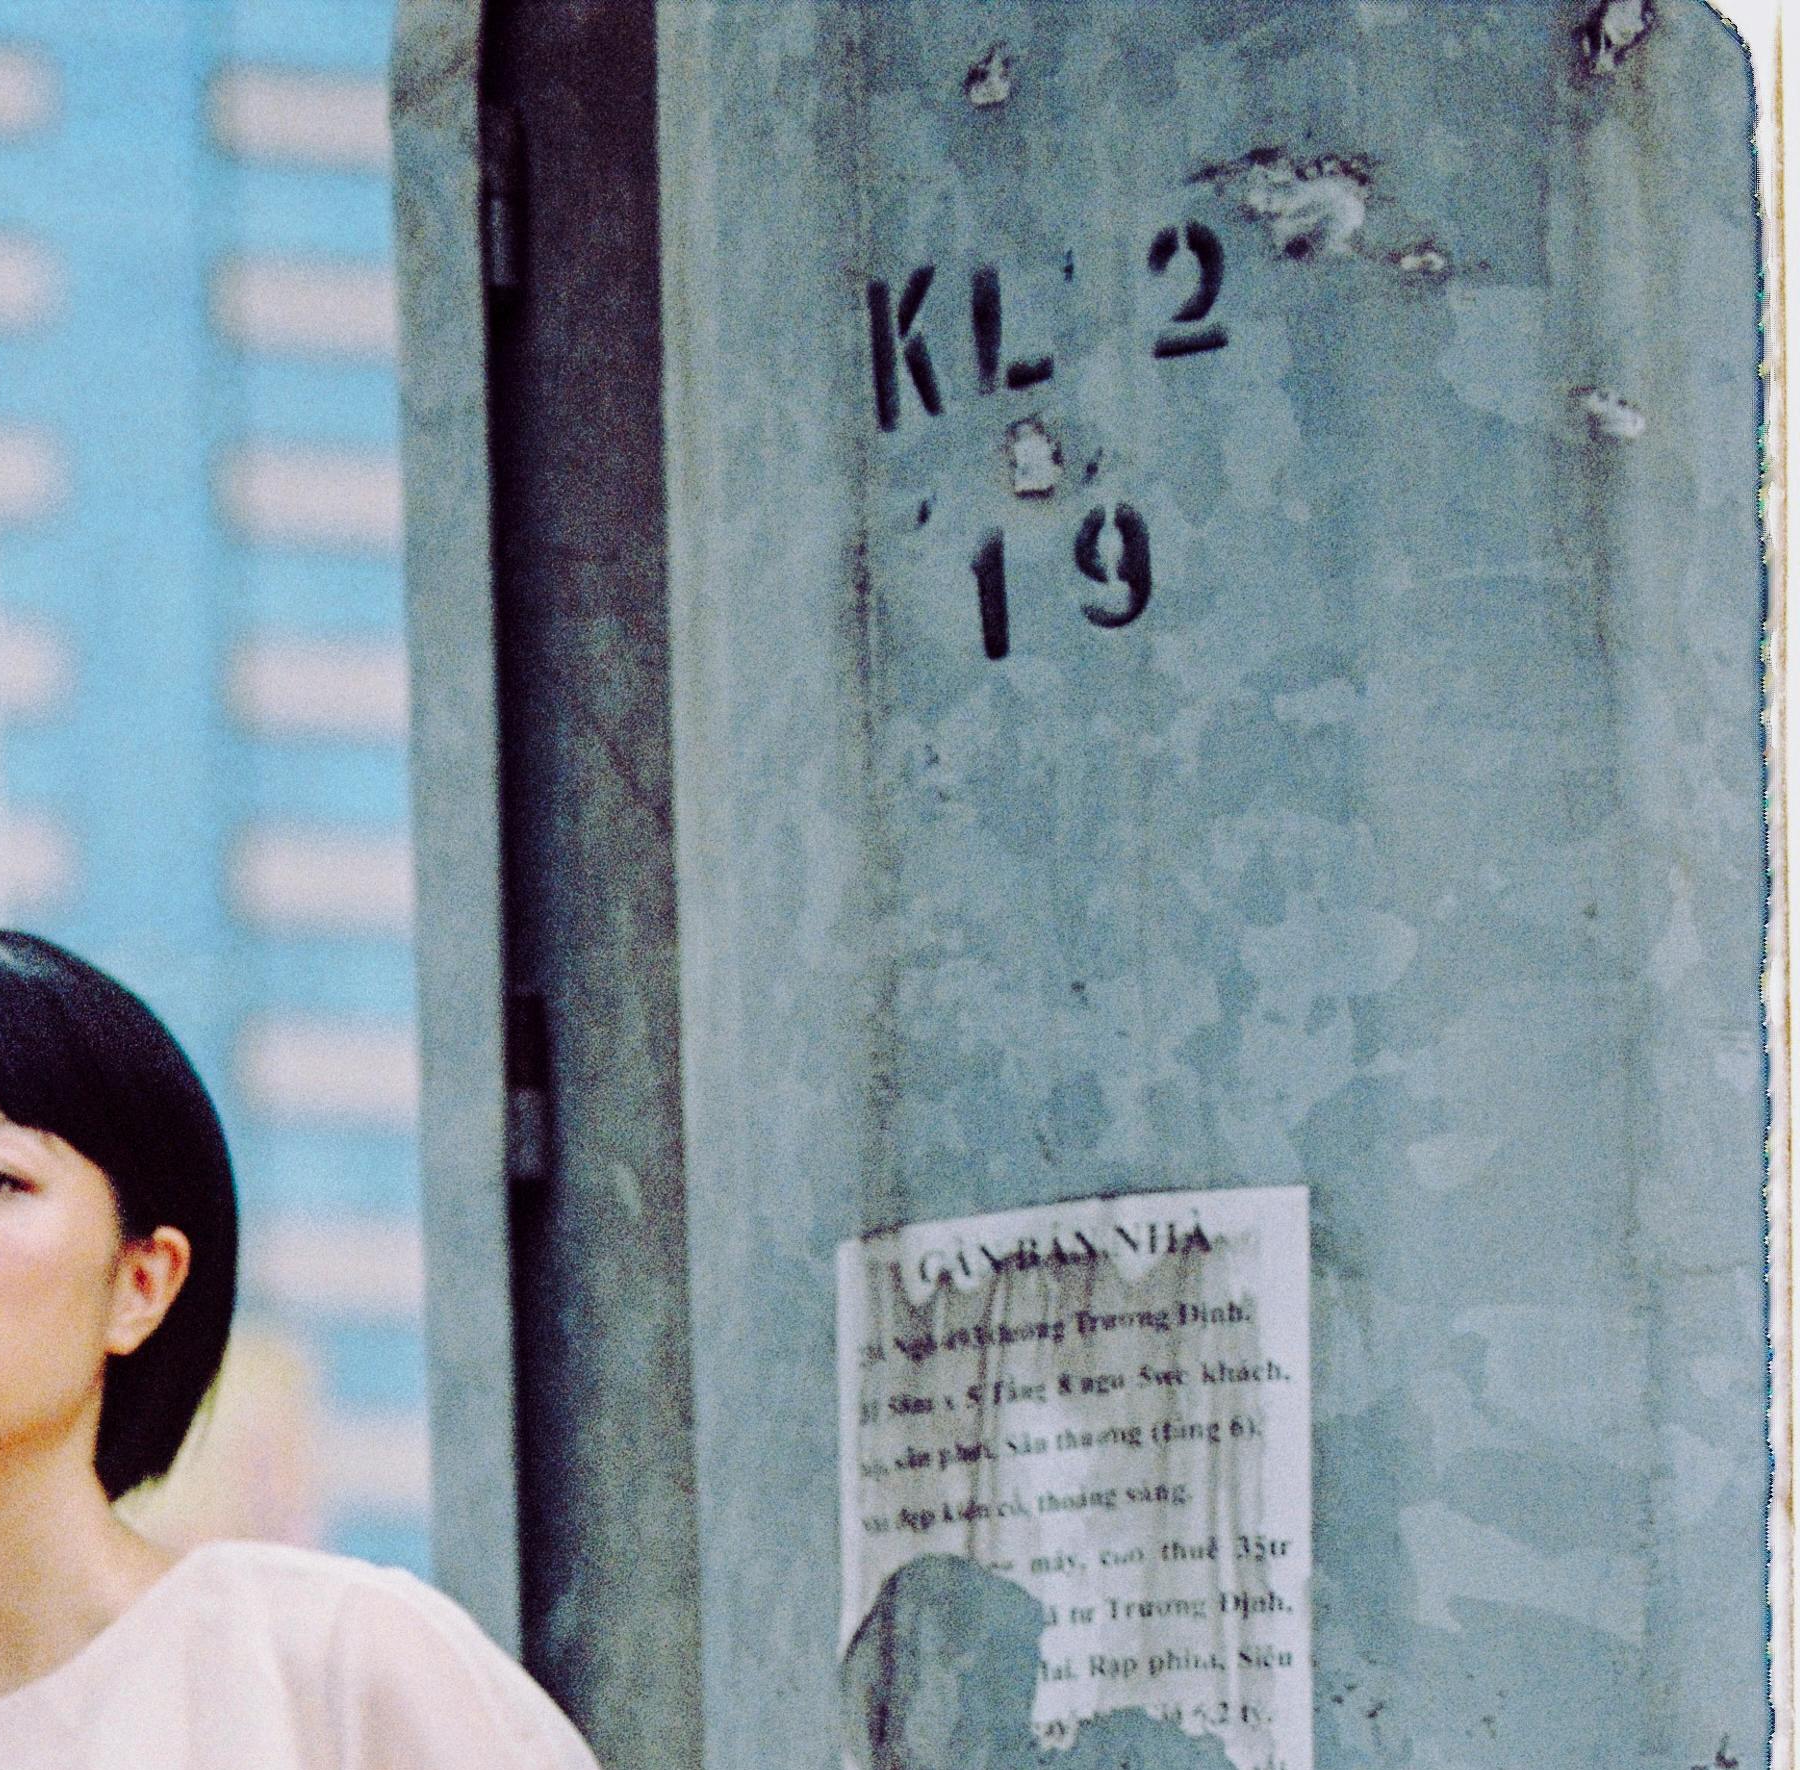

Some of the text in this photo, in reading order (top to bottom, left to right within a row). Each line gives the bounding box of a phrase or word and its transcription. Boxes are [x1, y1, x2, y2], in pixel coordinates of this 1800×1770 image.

[866, 220, 1230, 433] KL 2
[970, 501, 1154, 662] 19
